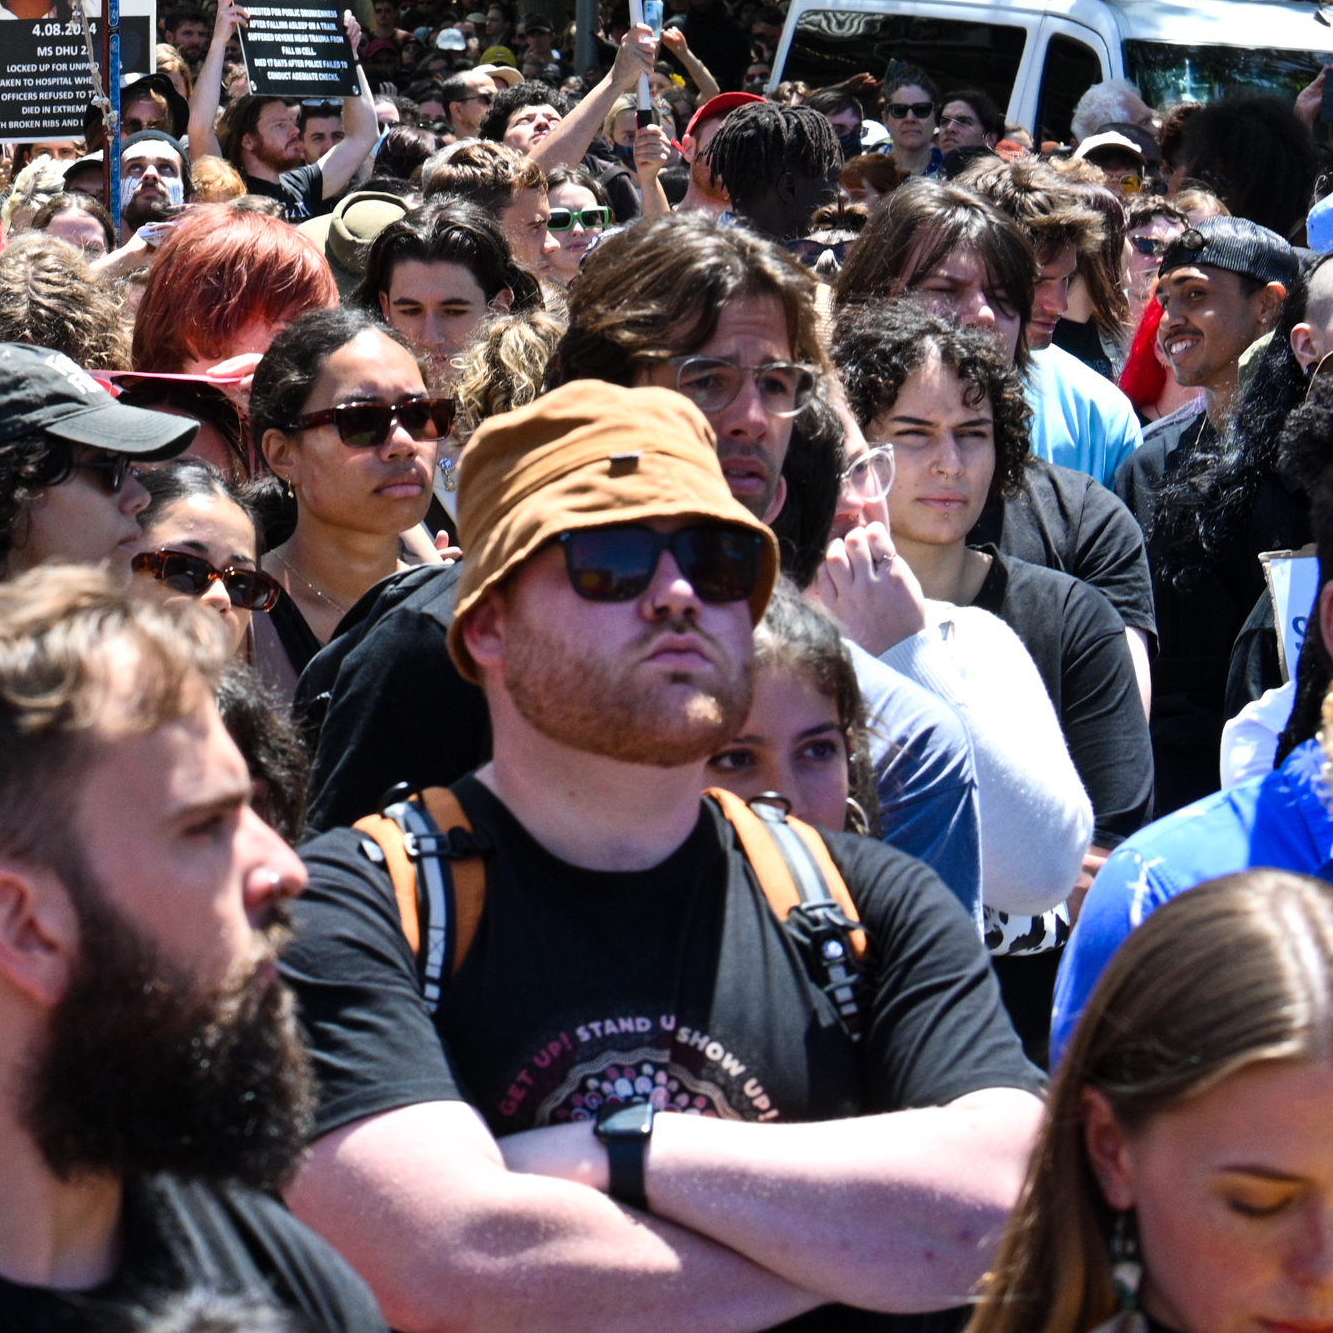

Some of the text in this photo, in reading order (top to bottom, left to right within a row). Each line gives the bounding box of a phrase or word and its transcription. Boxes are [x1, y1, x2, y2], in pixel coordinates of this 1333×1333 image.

[271, 7, 281, 16] FOR
[282, 8, 300, 17] PUBLIC
[300, 9, 338, 19] DRUNKENNESS
[249, 20, 266, 29] AFTER
[266, 20, 288, 29] FALLING
[288, 21, 308, 30] ASLEEP
[308, 22, 316, 30] ON
[316, 22, 321, 30] A
[247, 32, 344, 44] SUFFERED SEVERE HEAD TRAUMA FROM
[37, 45, 90, 57] MS DHU 2
[281, 46, 317, 56] FALL IN CELL.
[6, 63, 37, 73] LOCKED
[38, 63, 49, 73] UP
[51, 62, 68, 72] FOR
[254, 58, 348, 69] DIED 17 DAYS AFTER POLICE FAILED TO
[23, 77, 34, 87] TO
[35, 77, 73, 86] HOSPITAL
[74, 75, 94, 85] WHE
[267, 71, 340, 81] CONDUCT ADEQUATE CHECKS.
[1, 92, 38, 102] OFFICERS
[39, 91, 74, 101] REFUSED
[75, 90, 86, 99] TO
[21, 105, 41, 115] DIED
[41, 105, 51, 114] IN
[8, 119, 41, 129] BROKEN
[42, 118, 60, 128] RIBS
[61, 117, 79, 127] AND
[499, 1014, 780, 1122] GET UP! STAND U SHOW UP!
